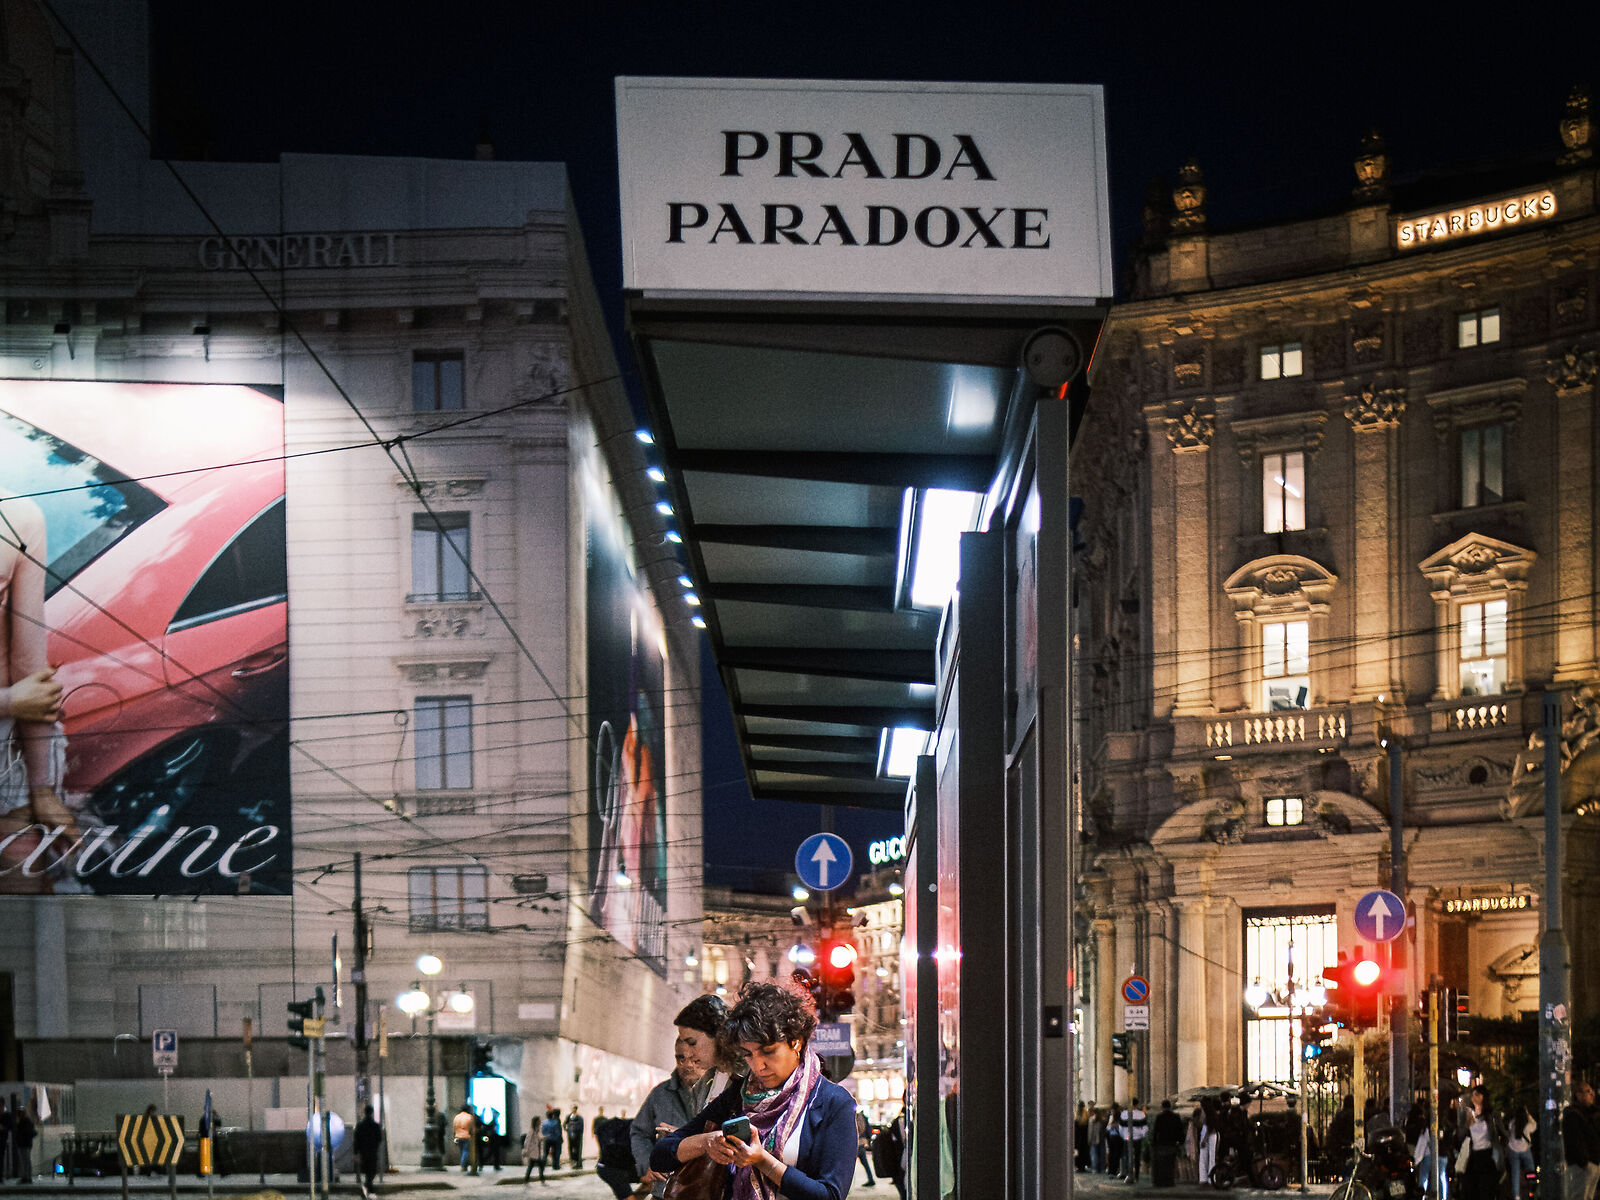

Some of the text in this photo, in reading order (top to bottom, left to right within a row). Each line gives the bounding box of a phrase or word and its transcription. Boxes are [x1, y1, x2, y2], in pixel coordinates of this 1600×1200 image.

[719, 130, 997, 181] PRADA
[665, 202, 1051, 249] PARADOXE
[1400, 195, 1553, 243] STARBUCKS
[200, 233, 400, 270] GENERALI
[1446, 895, 1527, 913] STARBUCKS
[815, 1028, 841, 1041] TRAM
